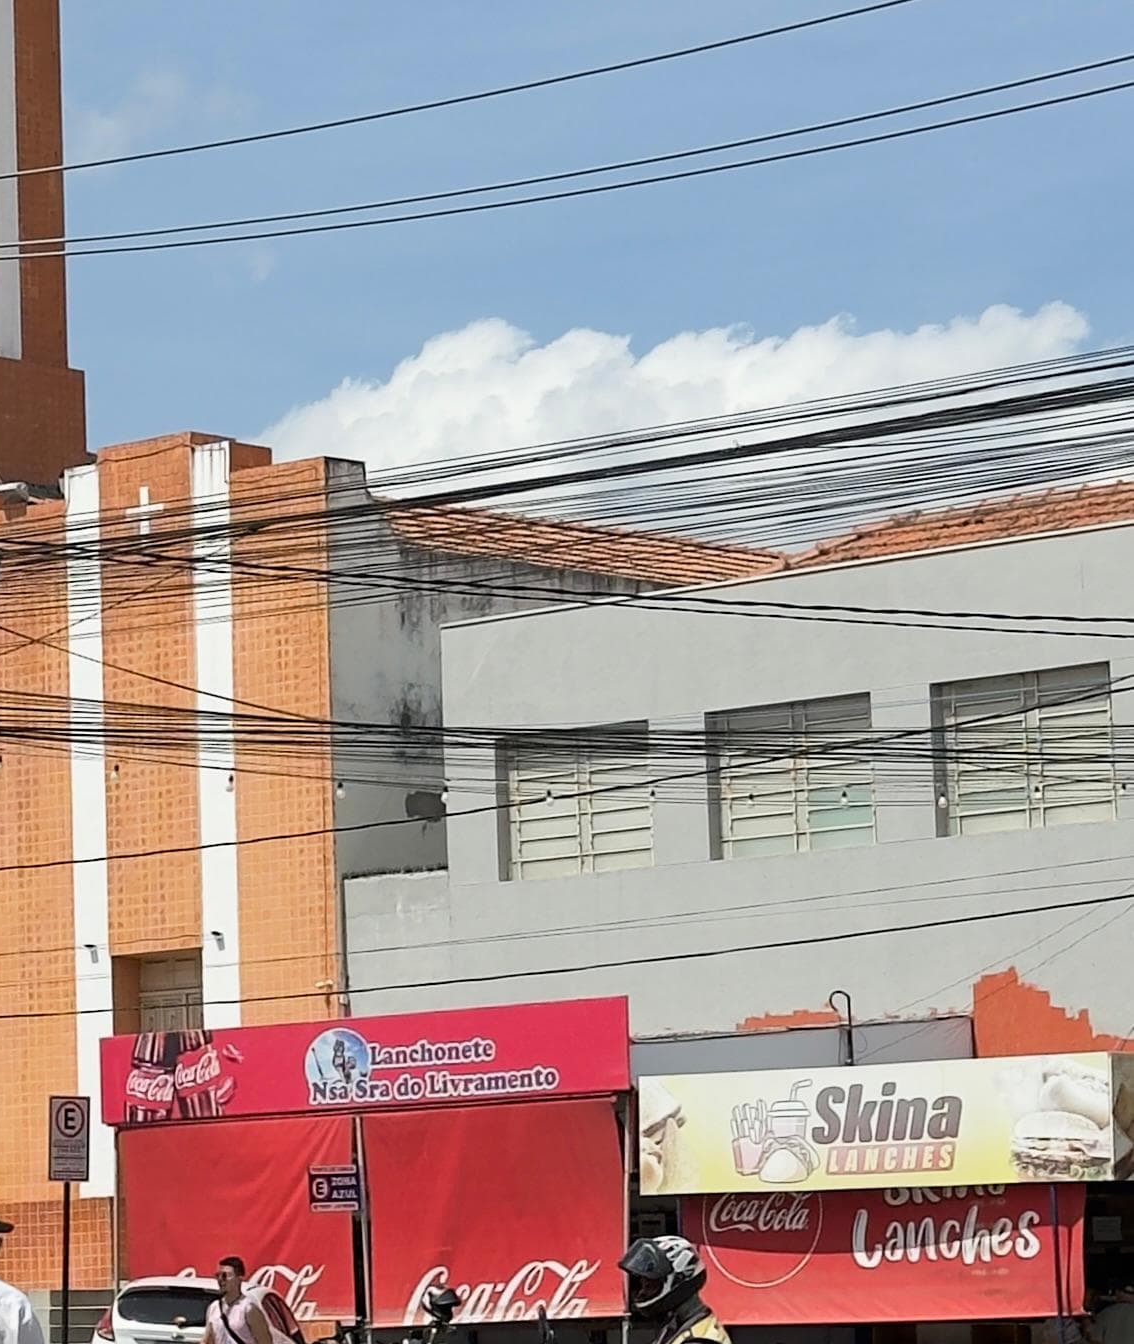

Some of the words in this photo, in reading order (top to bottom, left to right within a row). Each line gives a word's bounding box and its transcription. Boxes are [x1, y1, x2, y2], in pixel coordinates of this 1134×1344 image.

[369, 1039, 494, 1066] Lanchonete
[354, 1080, 391, 1100] Sra
[396, 1076, 423, 1098] do
[428, 1067, 558, 1093] Livramento
[64, 1108, 76, 1130] E
[811, 1081, 963, 1145] Skina
[828, 1145, 955, 1173] LANCHES
[852, 1205, 1041, 1269] Lanches
